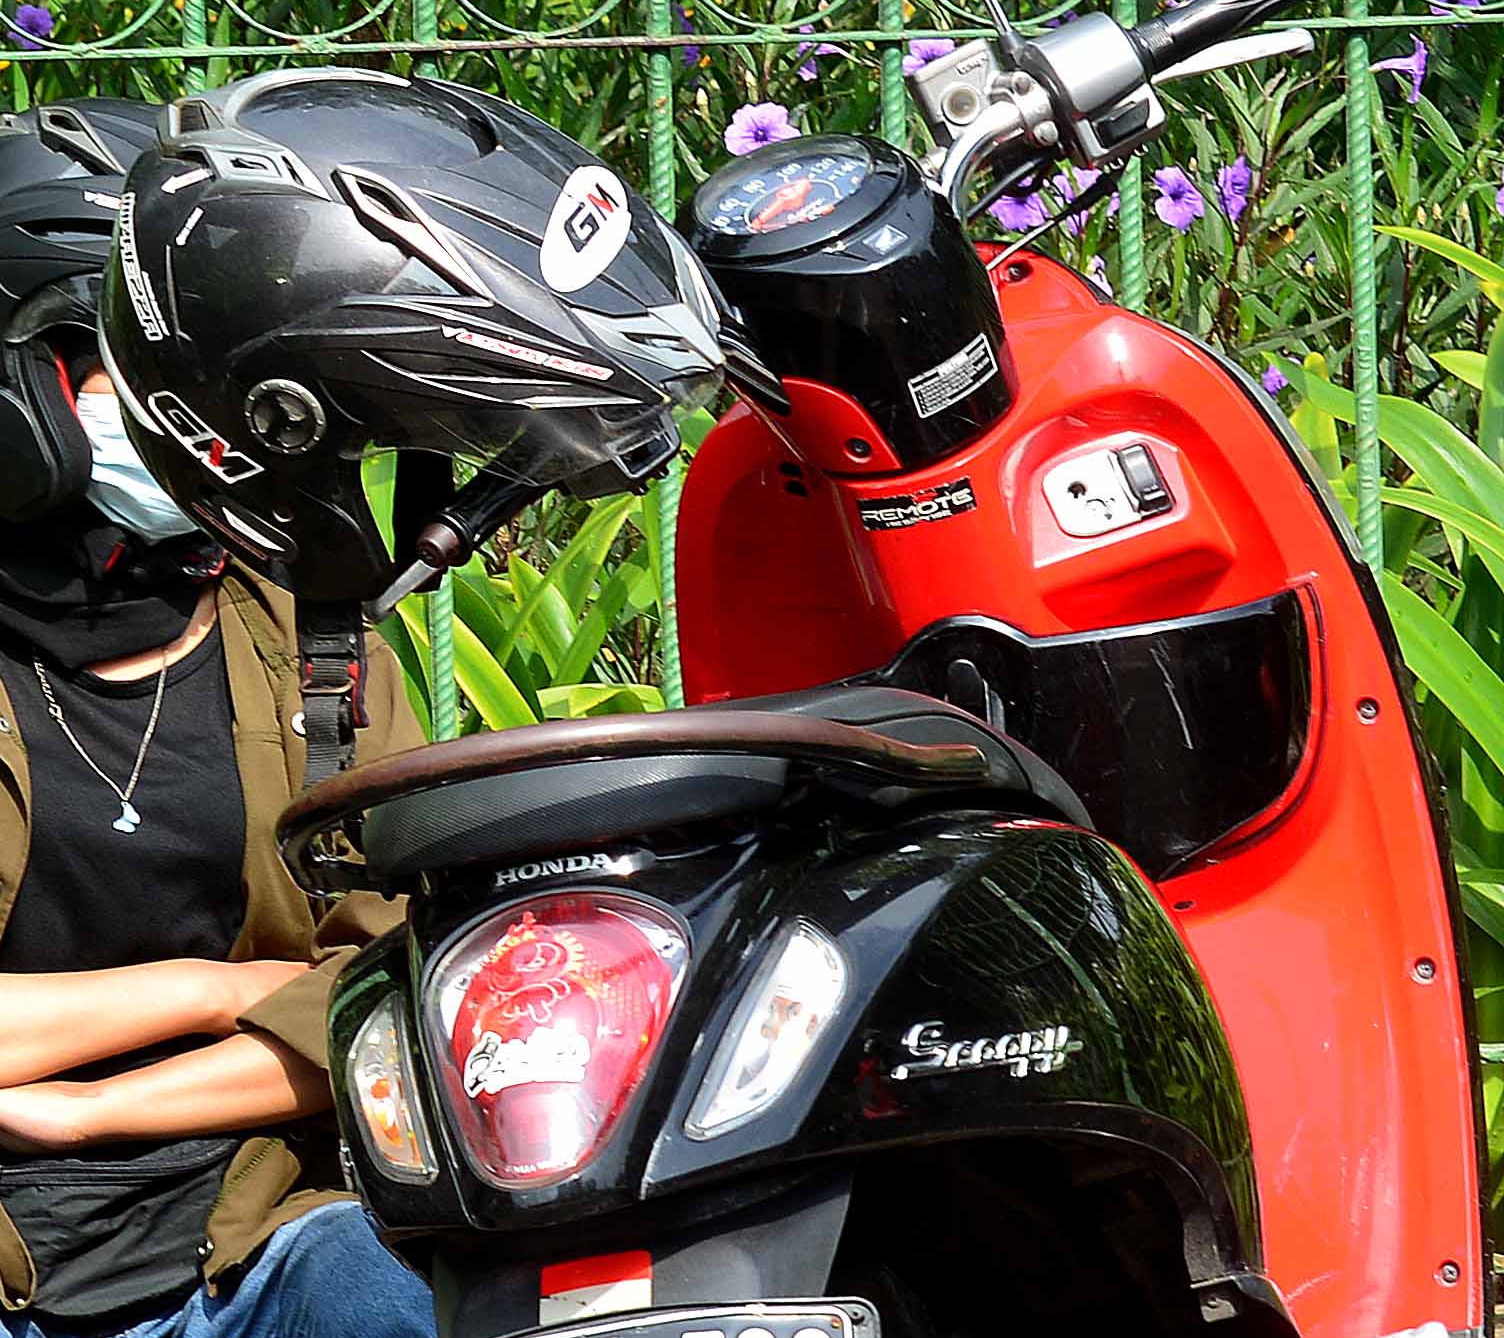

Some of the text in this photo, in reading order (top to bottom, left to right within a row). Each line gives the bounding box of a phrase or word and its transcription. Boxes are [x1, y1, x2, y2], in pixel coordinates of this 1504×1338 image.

[563, 181, 620, 254] GM
[147, 390, 265, 484] GM
[495, 853, 614, 887] HONDA
